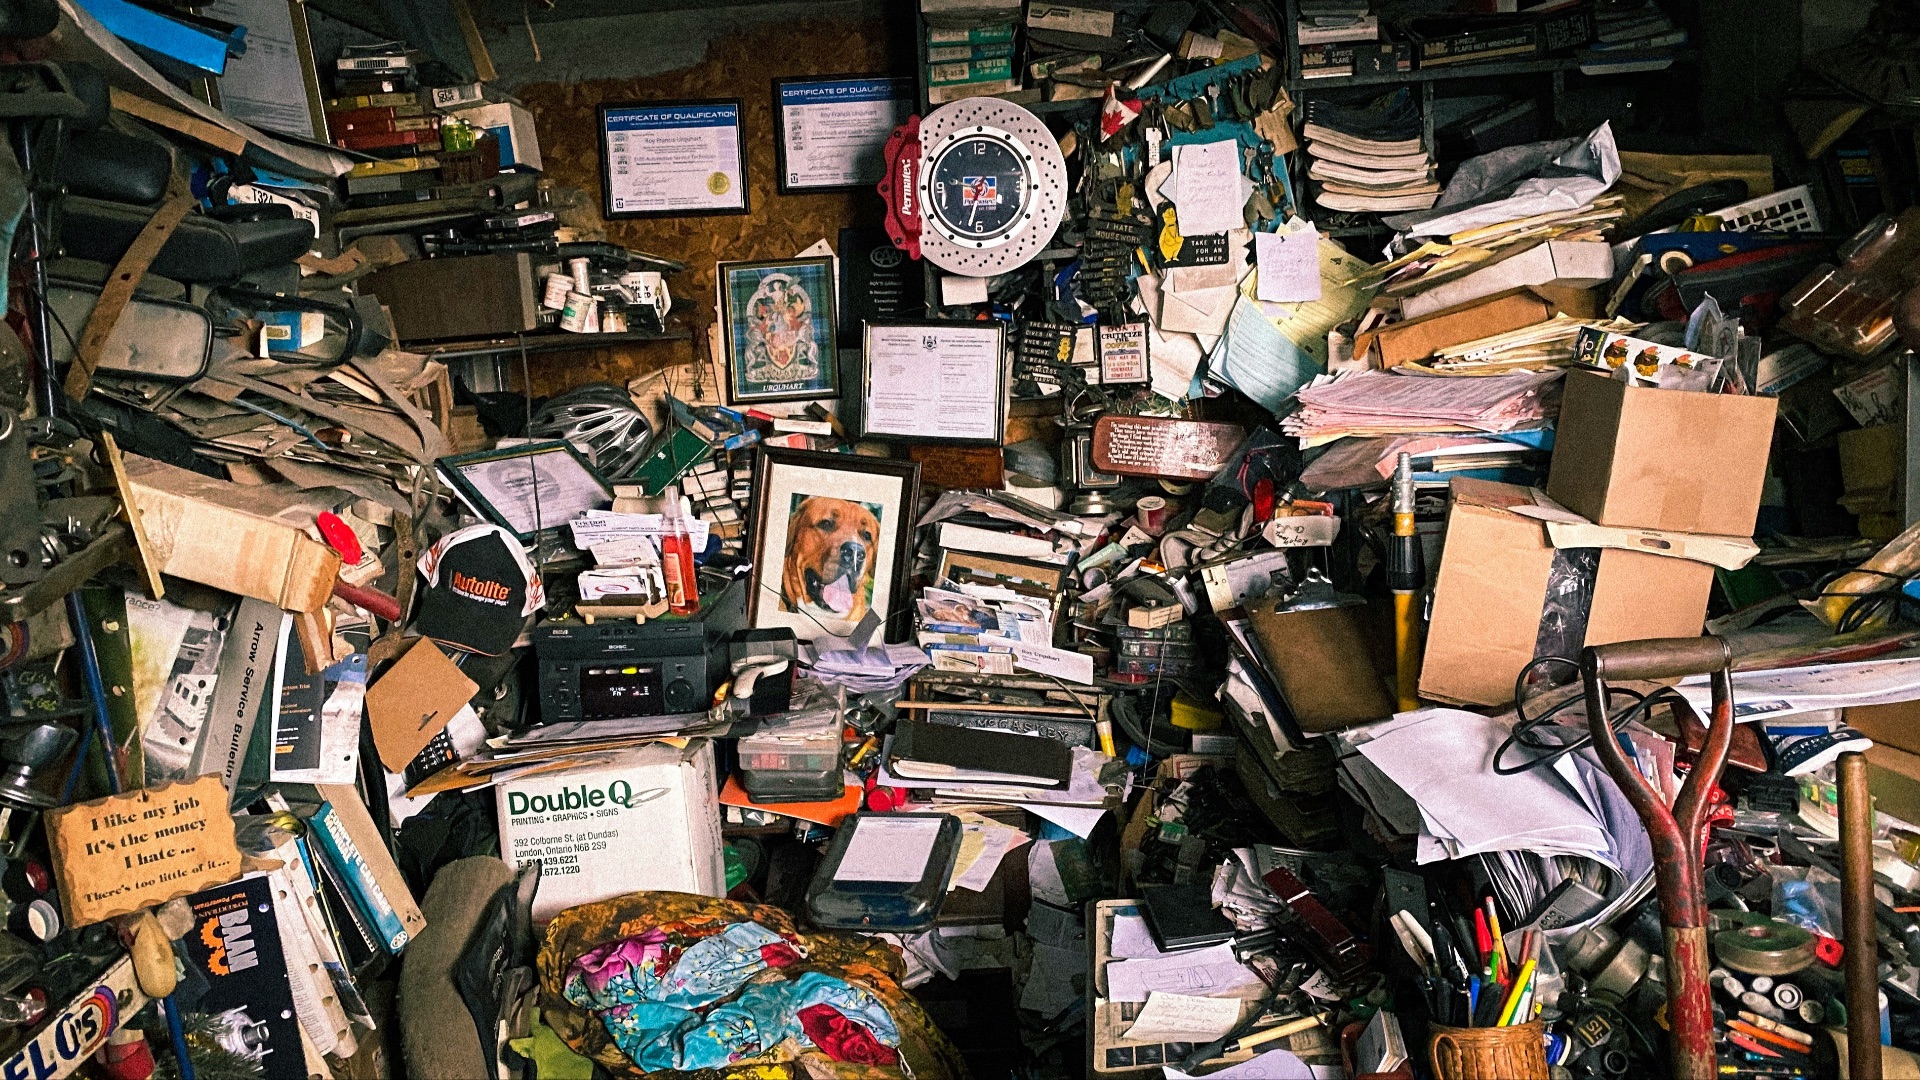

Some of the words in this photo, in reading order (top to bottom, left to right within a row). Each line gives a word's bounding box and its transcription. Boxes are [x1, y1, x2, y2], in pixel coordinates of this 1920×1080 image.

[783, 88, 835, 97] CERTIFICATE
[607, 115, 659, 123] CERTIFICATE
[674, 111, 736, 120] QUALIFICATION
[973, 142, 986, 155] 12
[902, 159, 912, 215] Permatex
[937, 182, 945, 194] 9
[975, 221, 984, 232] 6
[1113, 223, 1134, 232] HATE
[1101, 331, 1143, 340] CRITICIZE
[1105, 341, 1139, 349] COFFEE
[763, 382, 804, 392] URQUHART
[453, 571, 508, 600] Autolite
[248, 621, 264, 664] Arrow
[236, 666, 255, 719] Service
[225, 723, 243, 780] Bulletin
[508, 785, 605, 816] Double
[608, 780, 634, 809] Q
[91, 818, 98, 831] I
[103, 813, 137, 829] like
[143, 807, 167, 820] my
[172, 797, 200, 816] job
[511, 816, 545, 826] PRINTING
[552, 811, 588, 822] GRAPHICS
[596, 808, 619, 818] SIGNS
[85, 839, 116, 856] It's
[120, 831, 149, 848] the
[155, 818, 207, 839] money
[324, 815, 351, 865] MANUAL
[514, 838, 528, 847] 392
[530, 835, 563, 846] Colborne
[564, 833, 575, 842] St.
[576, 832, 586, 843] (at
[587, 829, 619, 841] Dundas)
[124, 856, 131, 869] I
[138, 847, 176, 866] hate
[515, 848, 545, 858] London,
[545, 846, 573, 855] Ontario
[574, 843, 590, 852] N6B
[591, 841, 607, 851] 2S9
[330, 809, 363, 866] COMPLETE
[359, 863, 377, 888] CAR
[373, 885, 392, 916] CARE
[516, 860, 524, 869] T:
[84, 884, 131, 903] There's
[135, 878, 155, 890] too
[159, 869, 188, 883] little
[191, 863, 204, 874] of
[194, 896, 230, 909] Powertrain
[219, 908, 259, 973] BAAN
